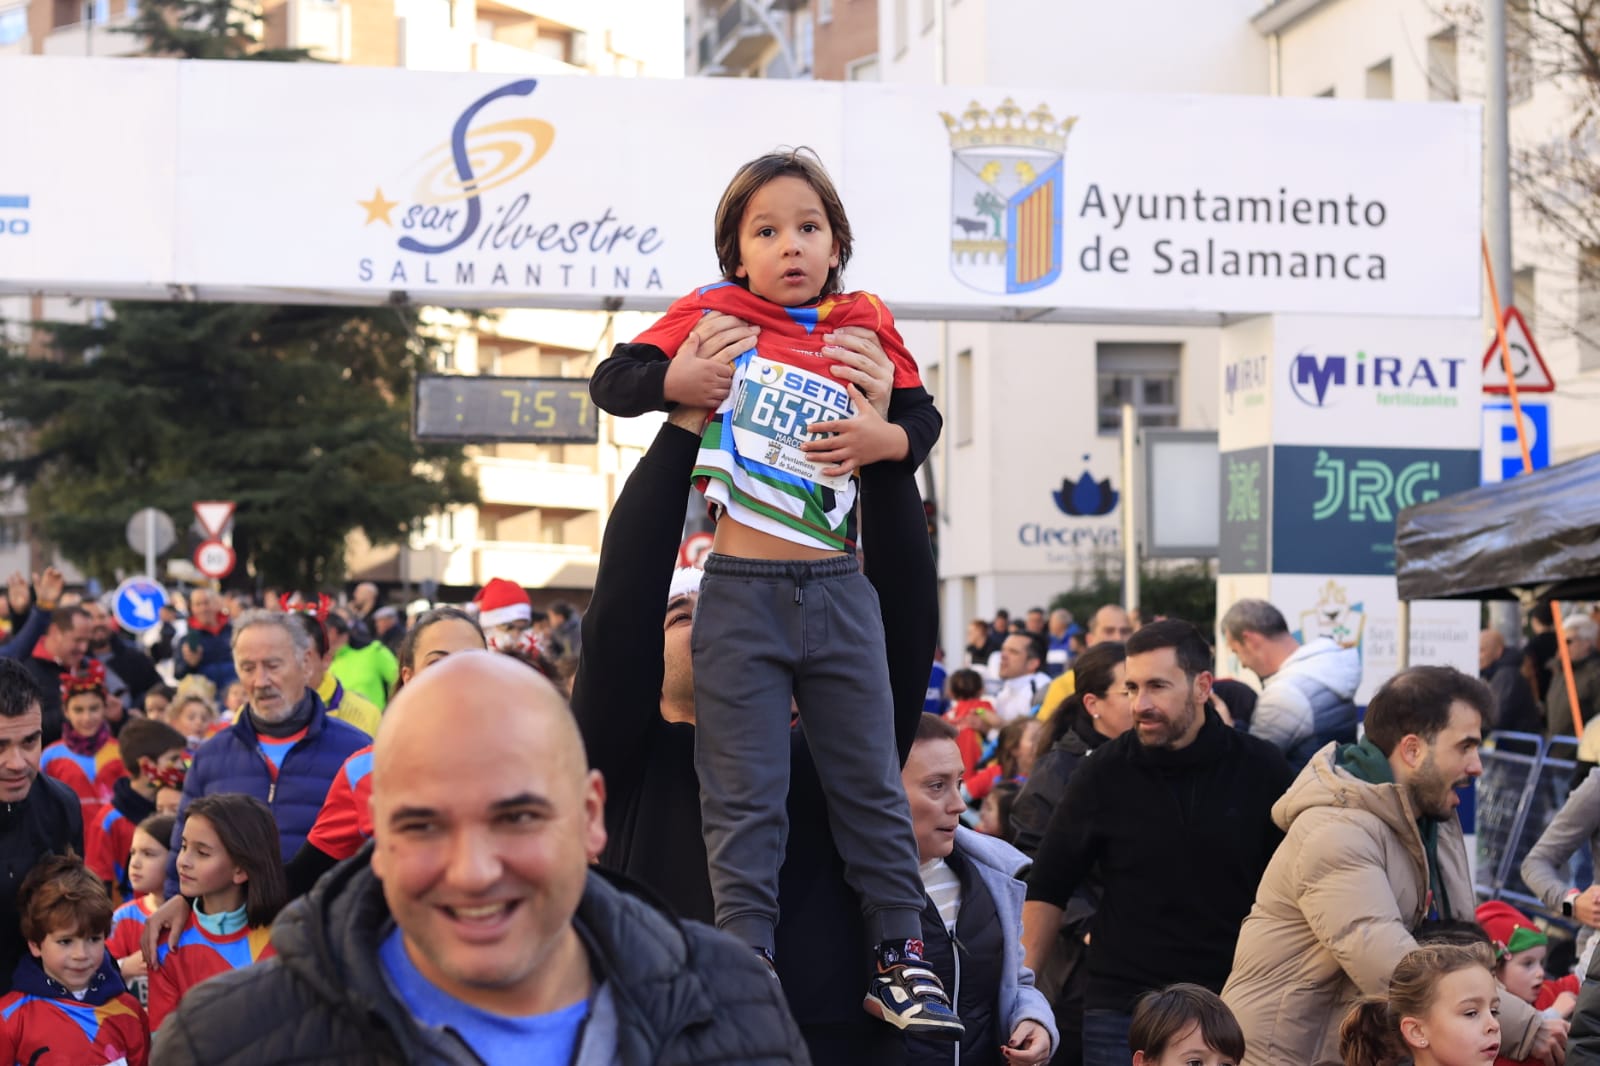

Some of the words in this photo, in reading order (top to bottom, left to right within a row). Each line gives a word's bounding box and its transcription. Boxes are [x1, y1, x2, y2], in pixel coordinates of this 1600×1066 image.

[1079, 183, 1387, 230] Ayuntamiento
[358, 258, 664, 290] SALMANTINA
[1079, 235, 1130, 273] de
[1152, 239, 1387, 280] Salamanca
[781, 453, 816, 470] Ayuntamiento
[1482, 409, 1537, 483] P
